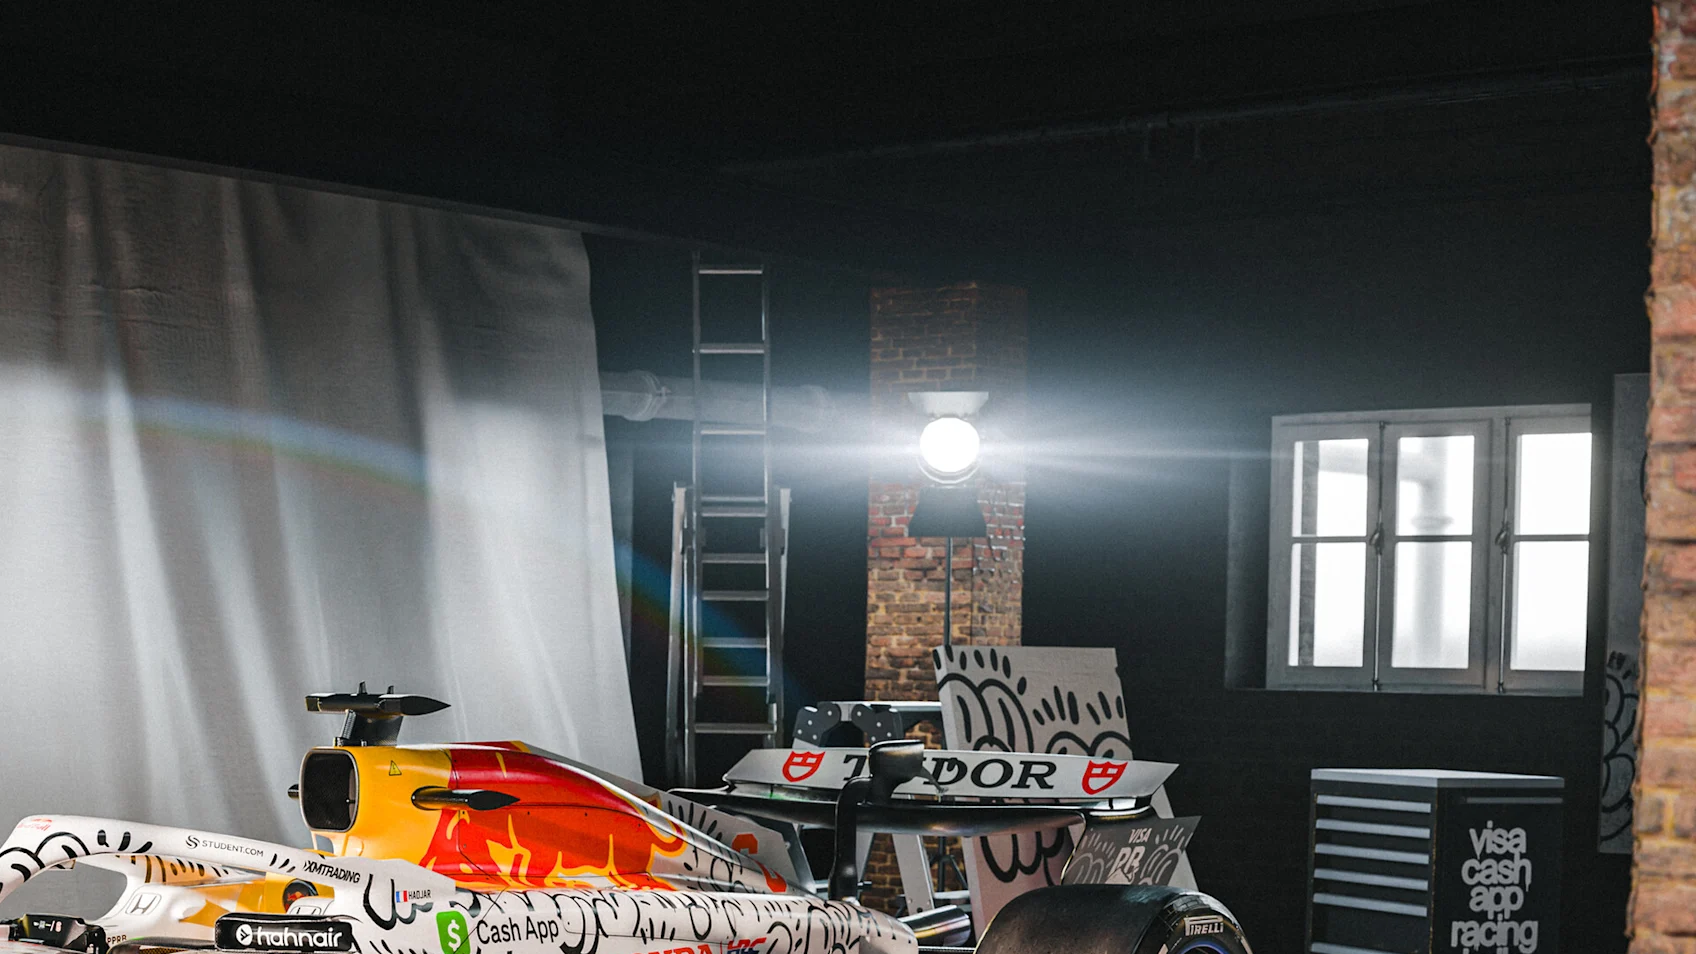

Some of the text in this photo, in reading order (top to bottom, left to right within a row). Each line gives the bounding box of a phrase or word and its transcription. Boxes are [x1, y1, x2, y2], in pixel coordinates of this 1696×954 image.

[842, 753, 1057, 790] TDOR
[202, 839, 264, 857] STUDENT.COM
[1128, 828, 1153, 843] VISA
[1468, 820, 1527, 856] visa
[1461, 852, 1533, 889] cash
[1468, 885, 1525, 920] app
[256, 926, 344, 948] hahnair
[476, 917, 522, 945] Cash
[525, 915, 560, 944] App
[1184, 914, 1224, 936] PIRELLI
[1450, 913, 1539, 954] racing
